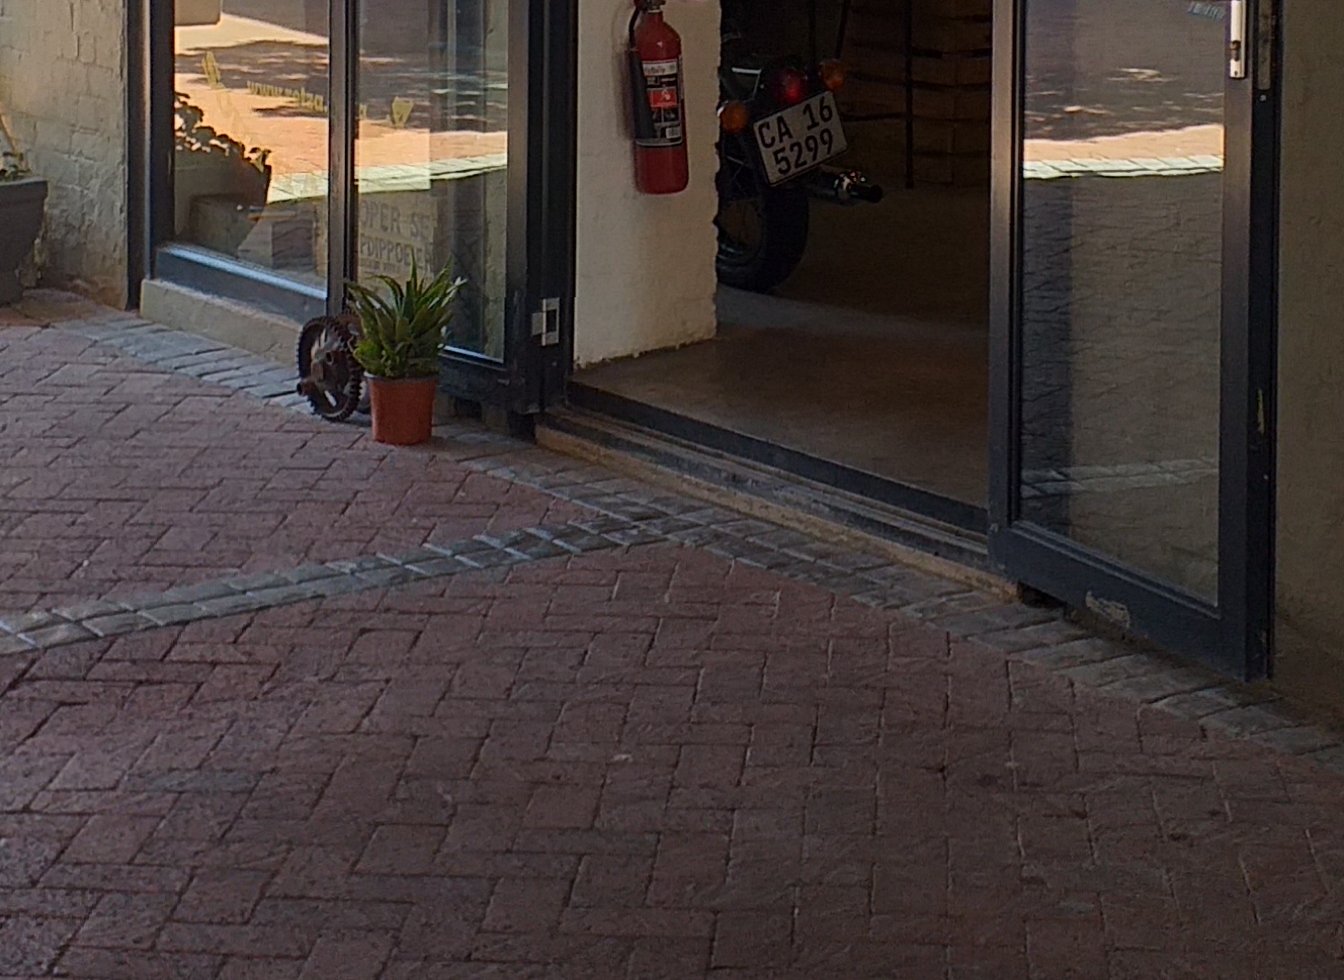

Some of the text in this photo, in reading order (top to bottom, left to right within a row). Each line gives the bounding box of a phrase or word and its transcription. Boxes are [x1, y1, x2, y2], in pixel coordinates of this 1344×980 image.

[758, 96, 833, 148] CA 16
[772, 128, 833, 175] 5299
